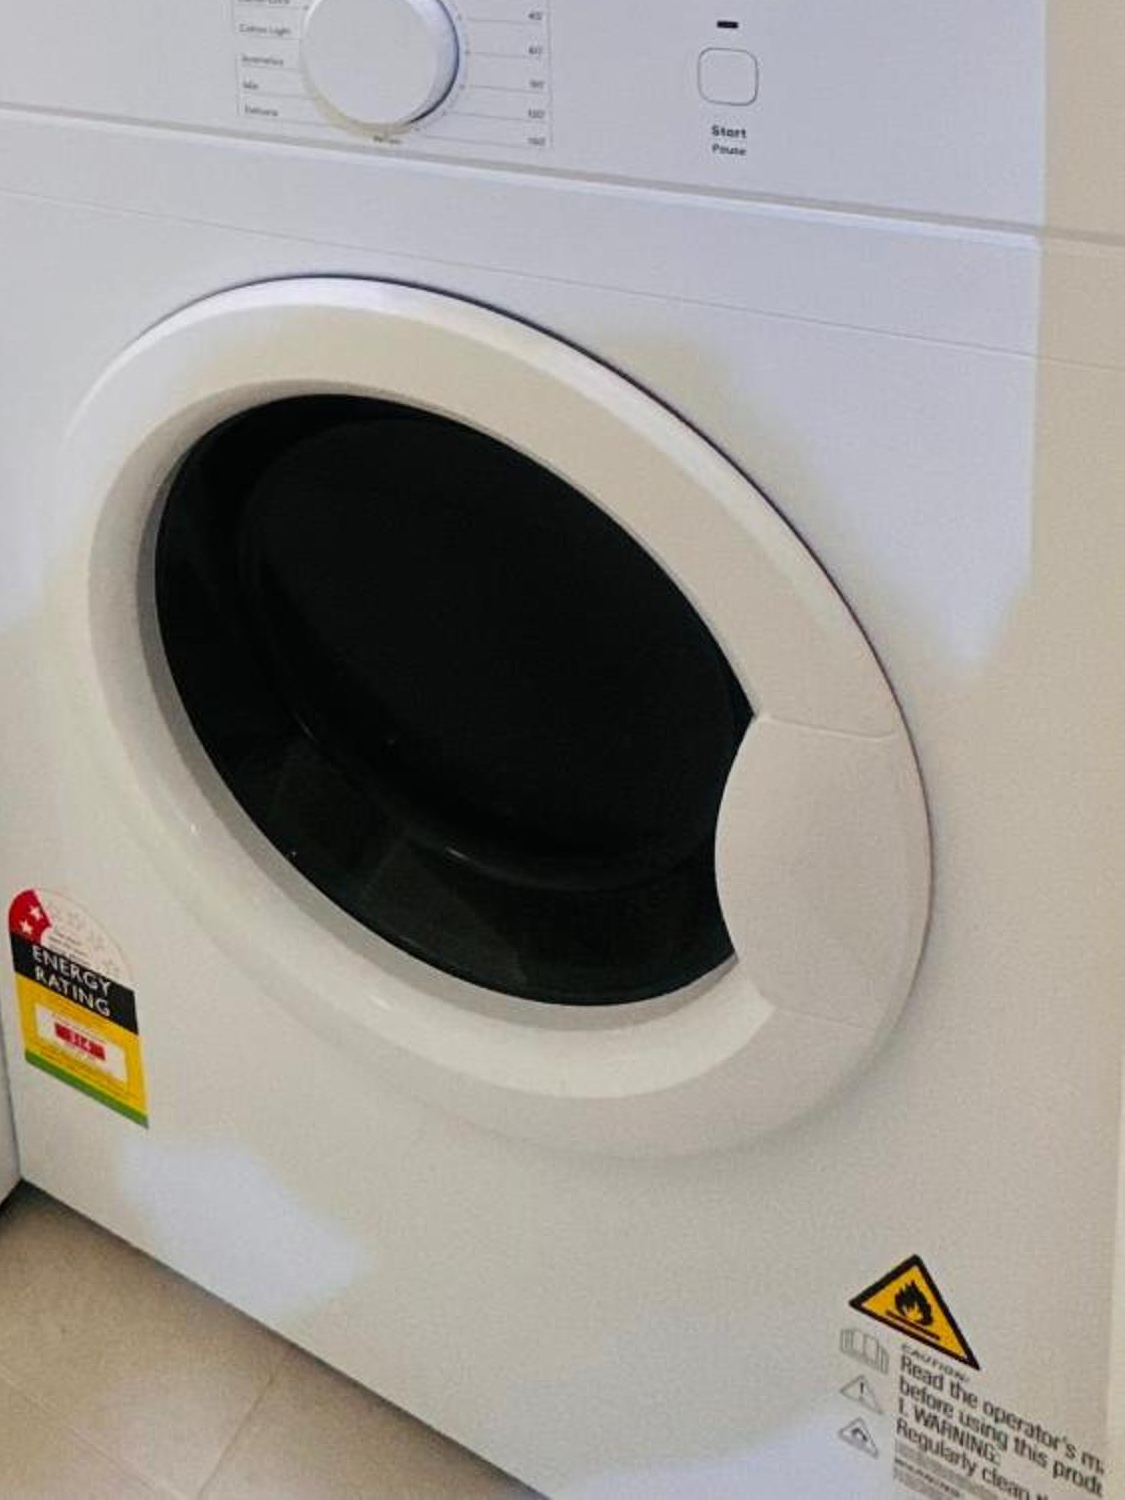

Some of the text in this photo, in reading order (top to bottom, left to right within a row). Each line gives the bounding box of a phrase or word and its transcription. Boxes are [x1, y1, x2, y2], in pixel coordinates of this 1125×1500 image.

[711, 125, 747, 139] Start
[711, 143, 747, 156] Pause
[32, 944, 111, 998] ENERGY
[35, 965, 111, 1018] RATING
[899, 1374, 954, 1419] before
[958, 1411, 1008, 1452] using
[1014, 1437, 1048, 1469] this
[900, 1354, 944, 1392] Read
[950, 1380, 978, 1410] the
[982, 1400, 1077, 1462] operator's
[915, 1403, 1002, 1468] WARNING:
[896, 1417, 978, 1477] Regularly
